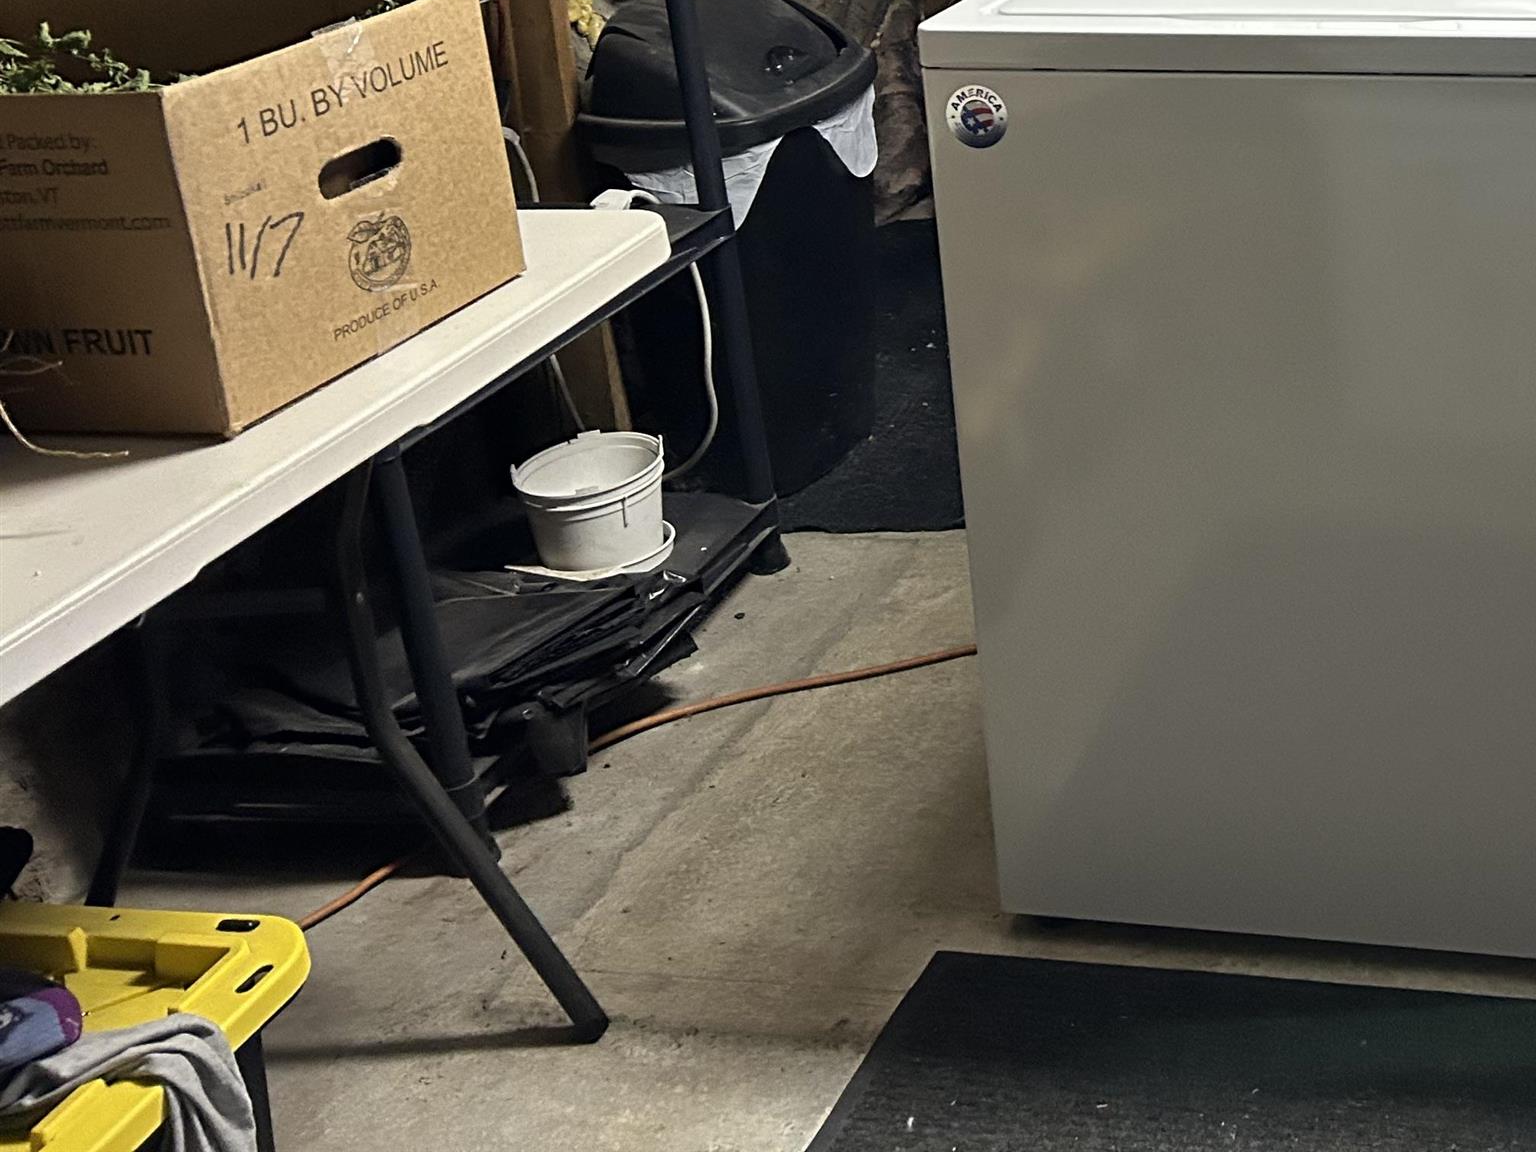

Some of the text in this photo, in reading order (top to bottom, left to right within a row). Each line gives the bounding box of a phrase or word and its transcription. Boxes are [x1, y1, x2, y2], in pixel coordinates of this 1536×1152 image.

[237, 40, 450, 145] 1 BU. BY VOLUME
[951, 88, 1003, 113] AMERICA
[8, 133, 65, 151] Packed
[42, 159, 109, 176] Orchard
[333, 305, 391, 341] PRODUCE
[392, 293, 409, 311] OF
[62, 329, 152, 355] FRUIT
